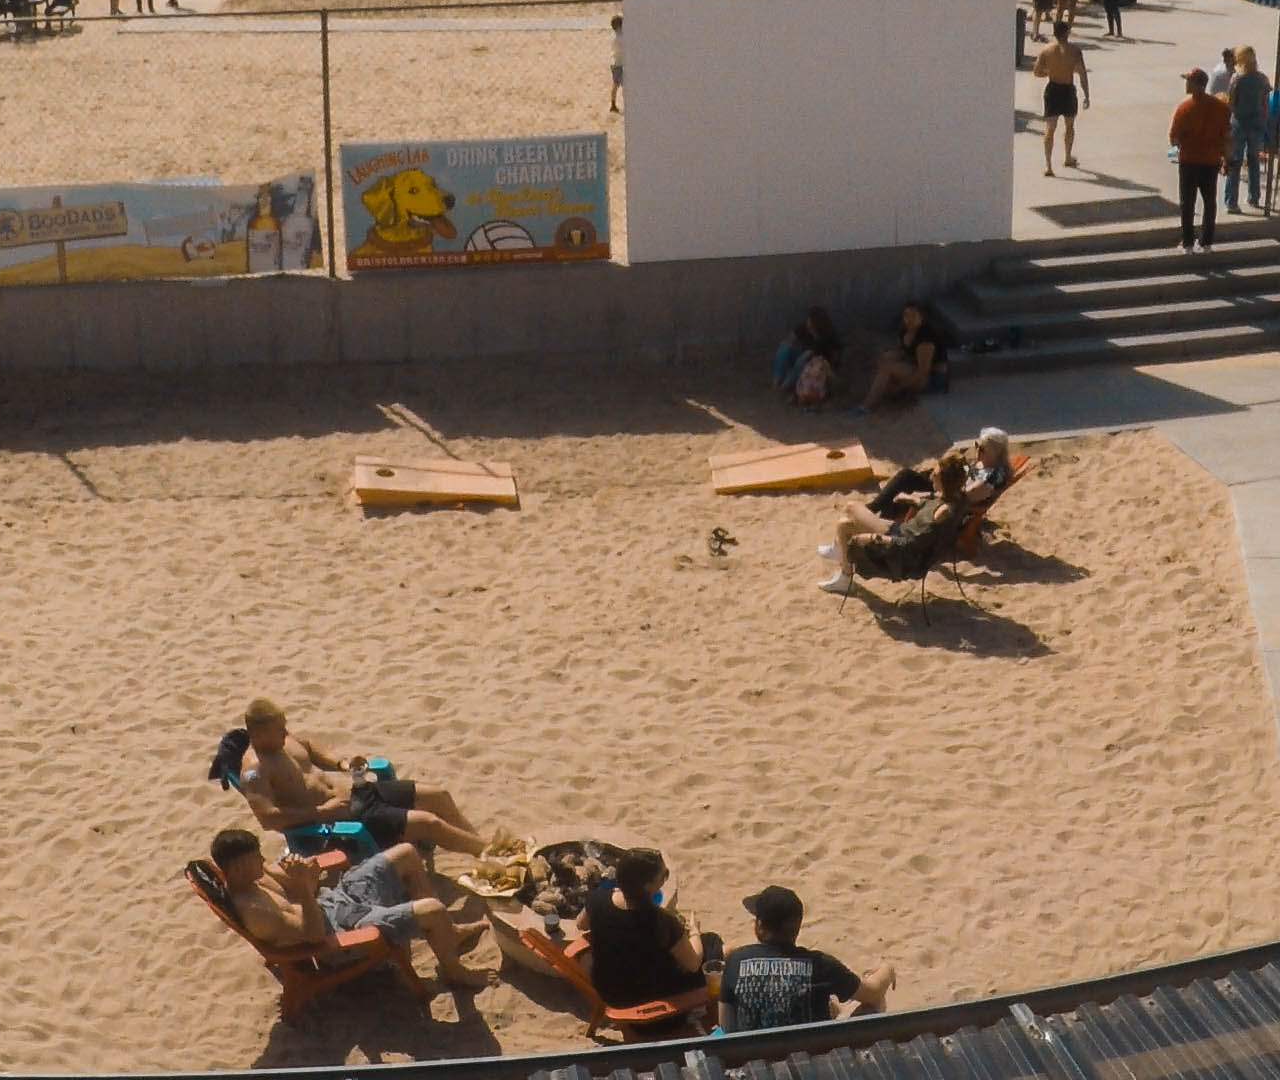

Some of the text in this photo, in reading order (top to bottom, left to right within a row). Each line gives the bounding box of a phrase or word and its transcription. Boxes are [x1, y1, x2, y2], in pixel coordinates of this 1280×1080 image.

[446, 141, 598, 168] DRINK BEER WITH
[495, 162, 598, 186] CHARACTER
